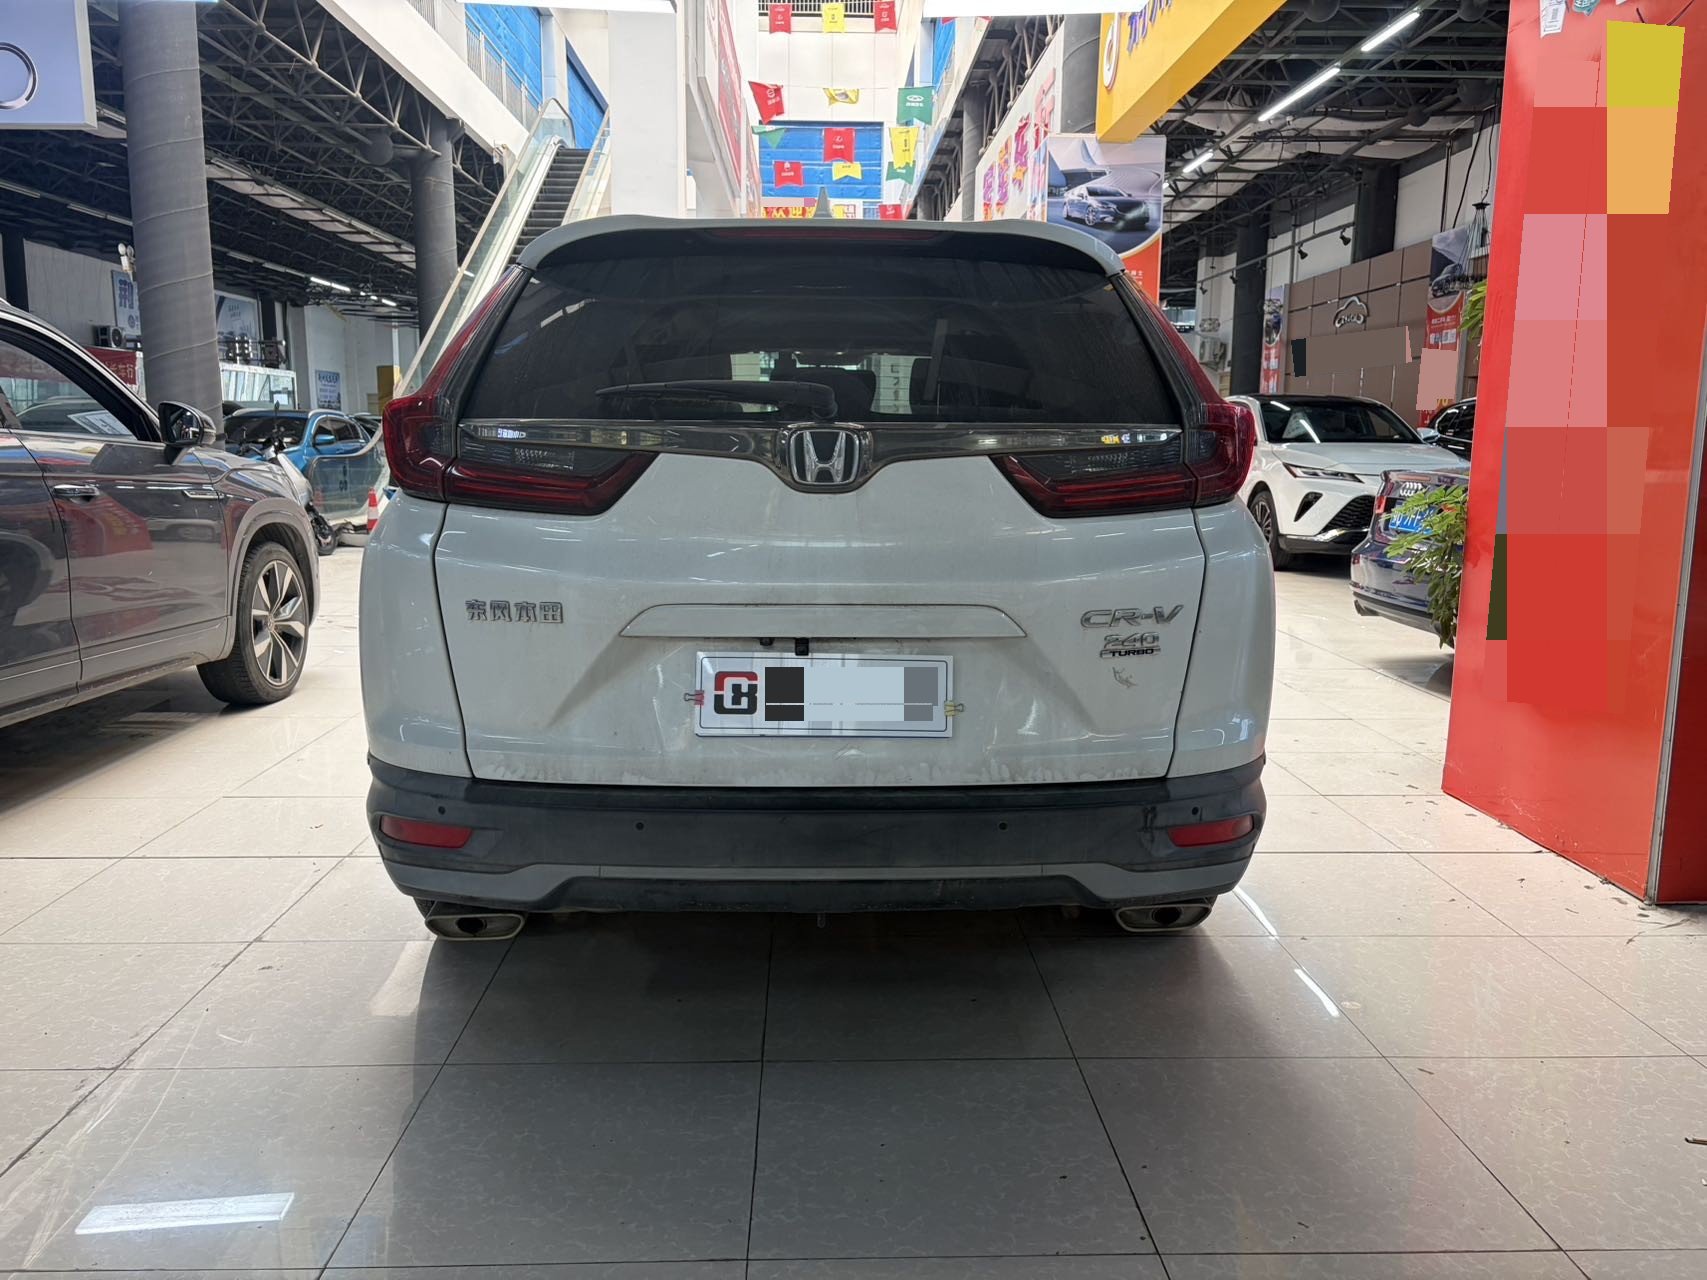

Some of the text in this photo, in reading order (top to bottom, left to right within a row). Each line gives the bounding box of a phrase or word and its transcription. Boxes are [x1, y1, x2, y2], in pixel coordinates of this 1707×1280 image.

[465, 599, 564, 624] 东风本田
[1080, 604, 1184, 629] CR-V
[1104, 631, 1160, 649] 240
[1110, 648, 1155, 657] TURBO
